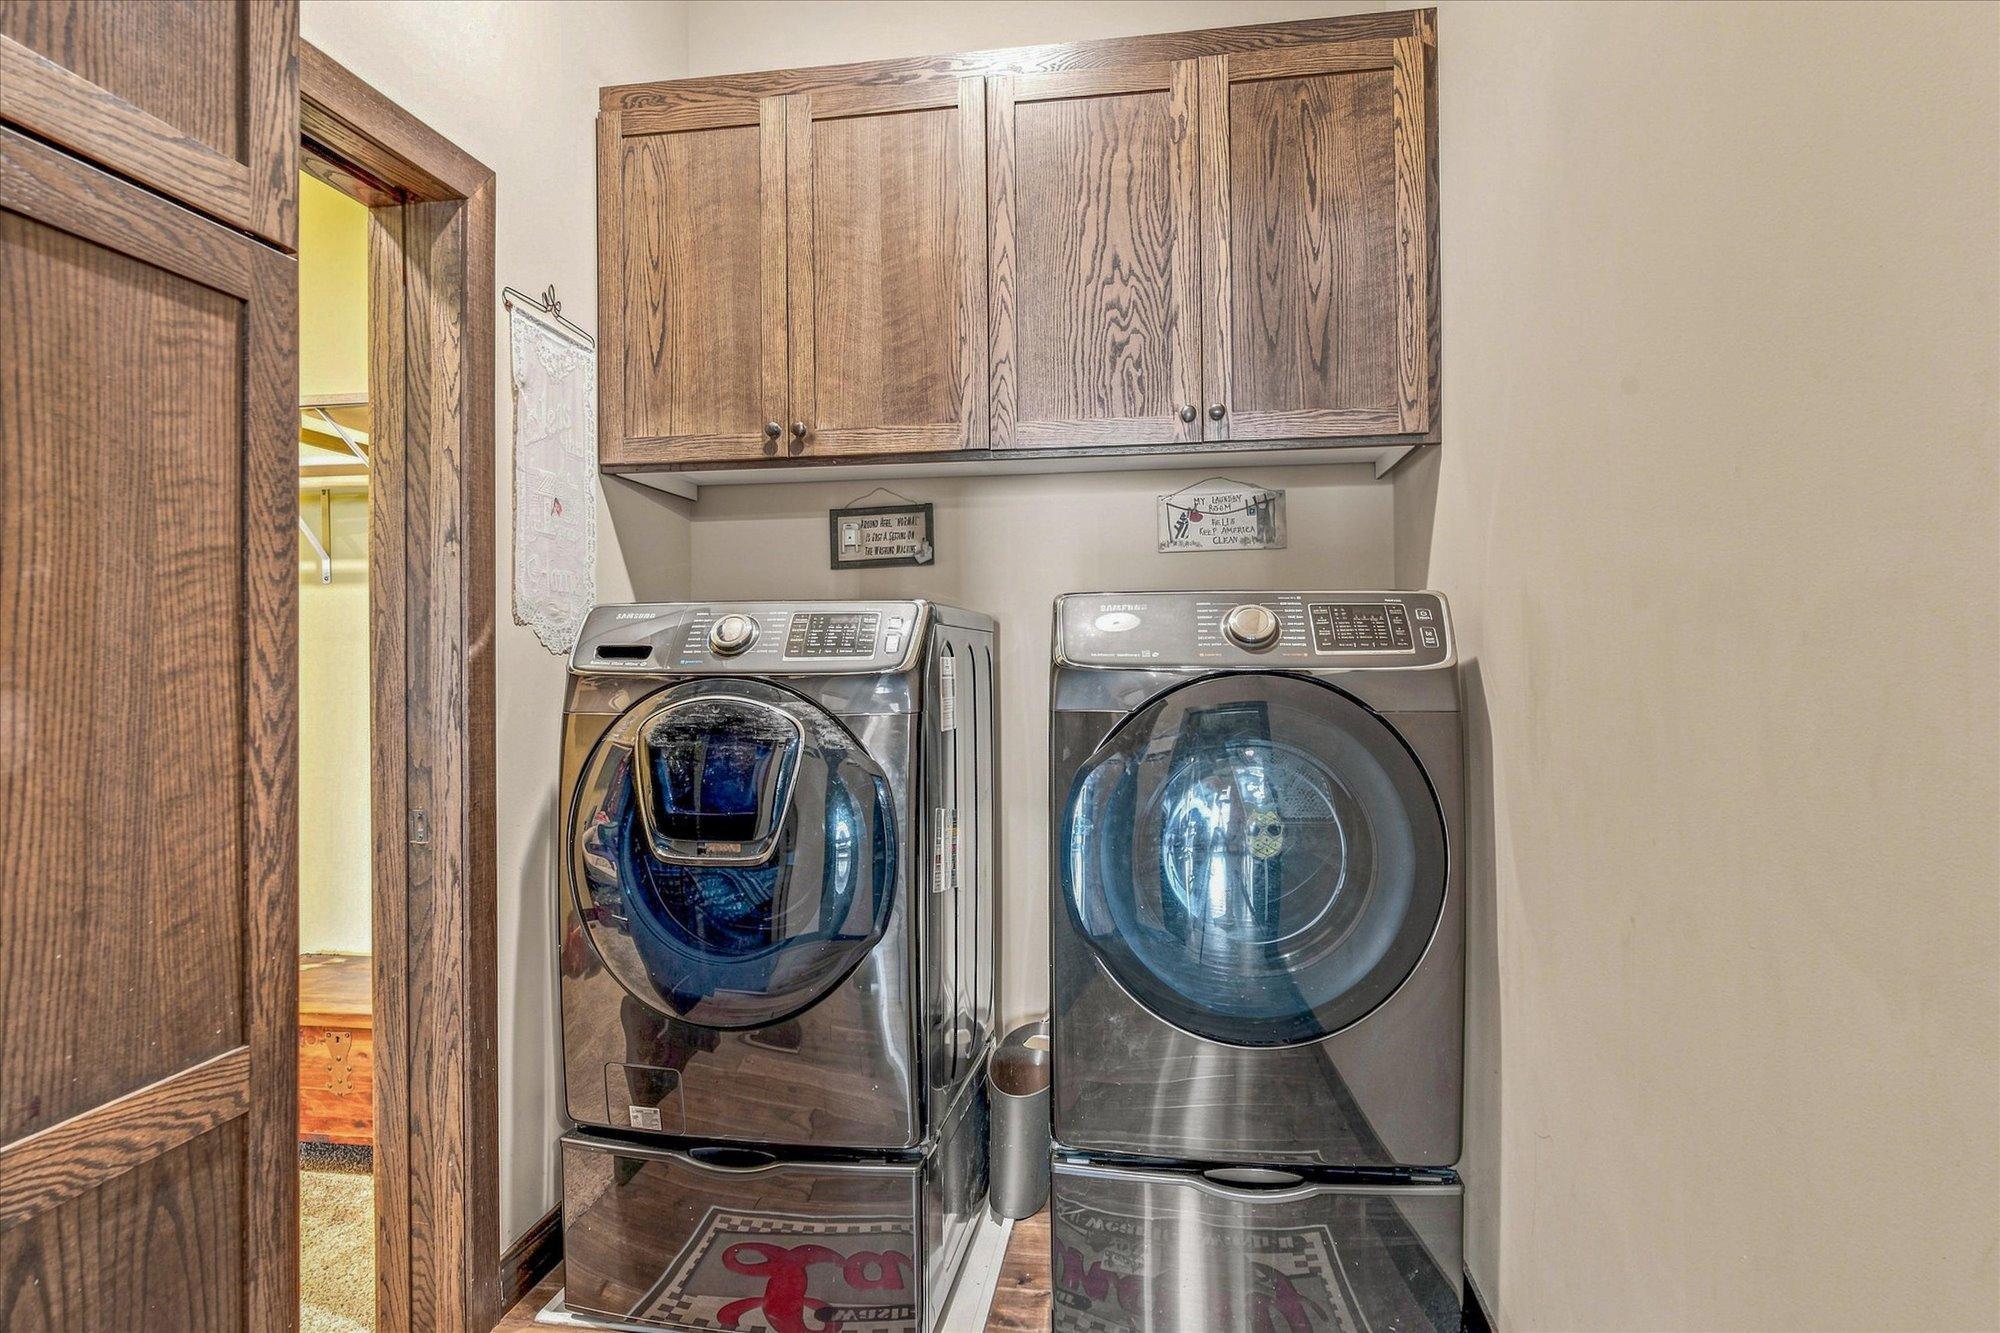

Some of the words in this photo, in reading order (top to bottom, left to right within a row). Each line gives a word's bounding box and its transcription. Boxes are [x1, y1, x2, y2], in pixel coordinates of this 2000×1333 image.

[1212, 495, 1242, 503] LAUNDRY
[1209, 503, 1231, 512] ROOM
[1221, 526, 1256, 534] AMERICA
[1100, 603, 1148, 612] SAMSUNG
[616, 612, 656, 620] SAMSUNG
